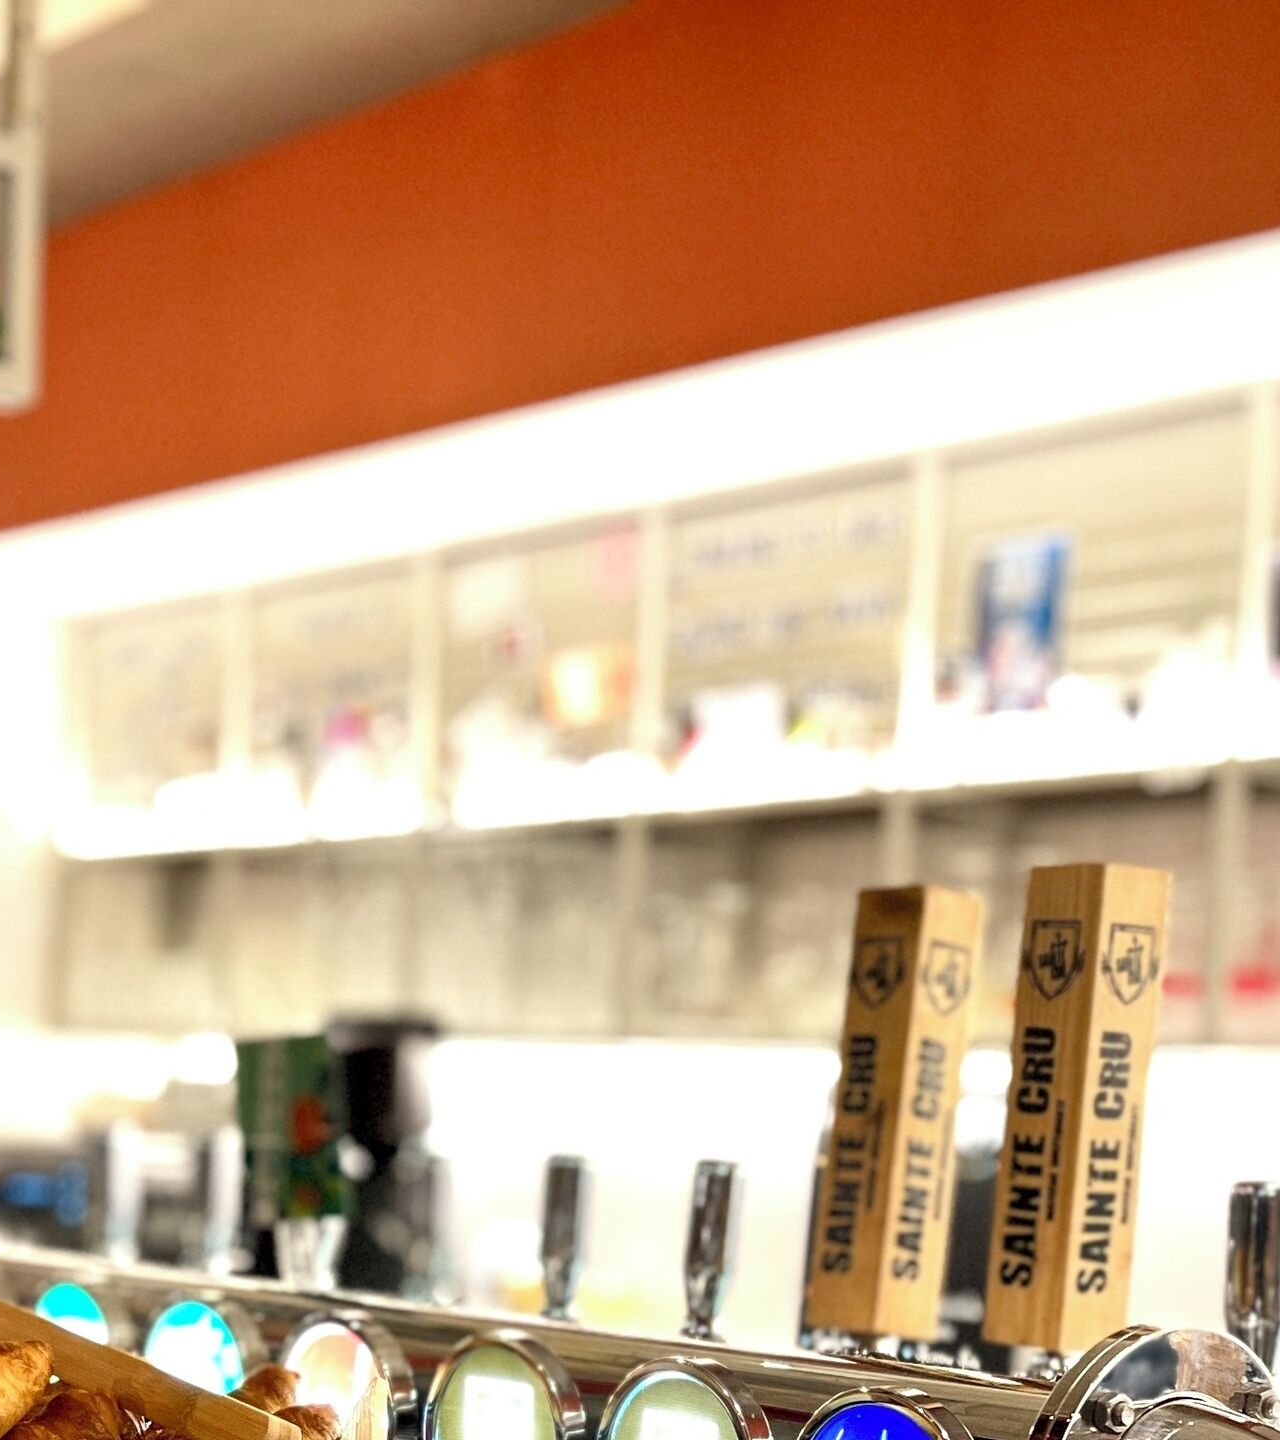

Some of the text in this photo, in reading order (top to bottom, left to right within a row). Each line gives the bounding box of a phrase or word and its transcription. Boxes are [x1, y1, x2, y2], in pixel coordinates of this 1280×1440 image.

[910, 1039, 948, 1121] CRU
[1017, 1026, 1056, 1114] CRU
[1094, 1031, 1133, 1120] CRU
[822, 1033, 879, 1275] SAINTE CRU
[891, 1141, 934, 1281] SAINTE
[1000, 1132, 1045, 1287] SAINTE
[1077, 1139, 1121, 1294] SAINTE
